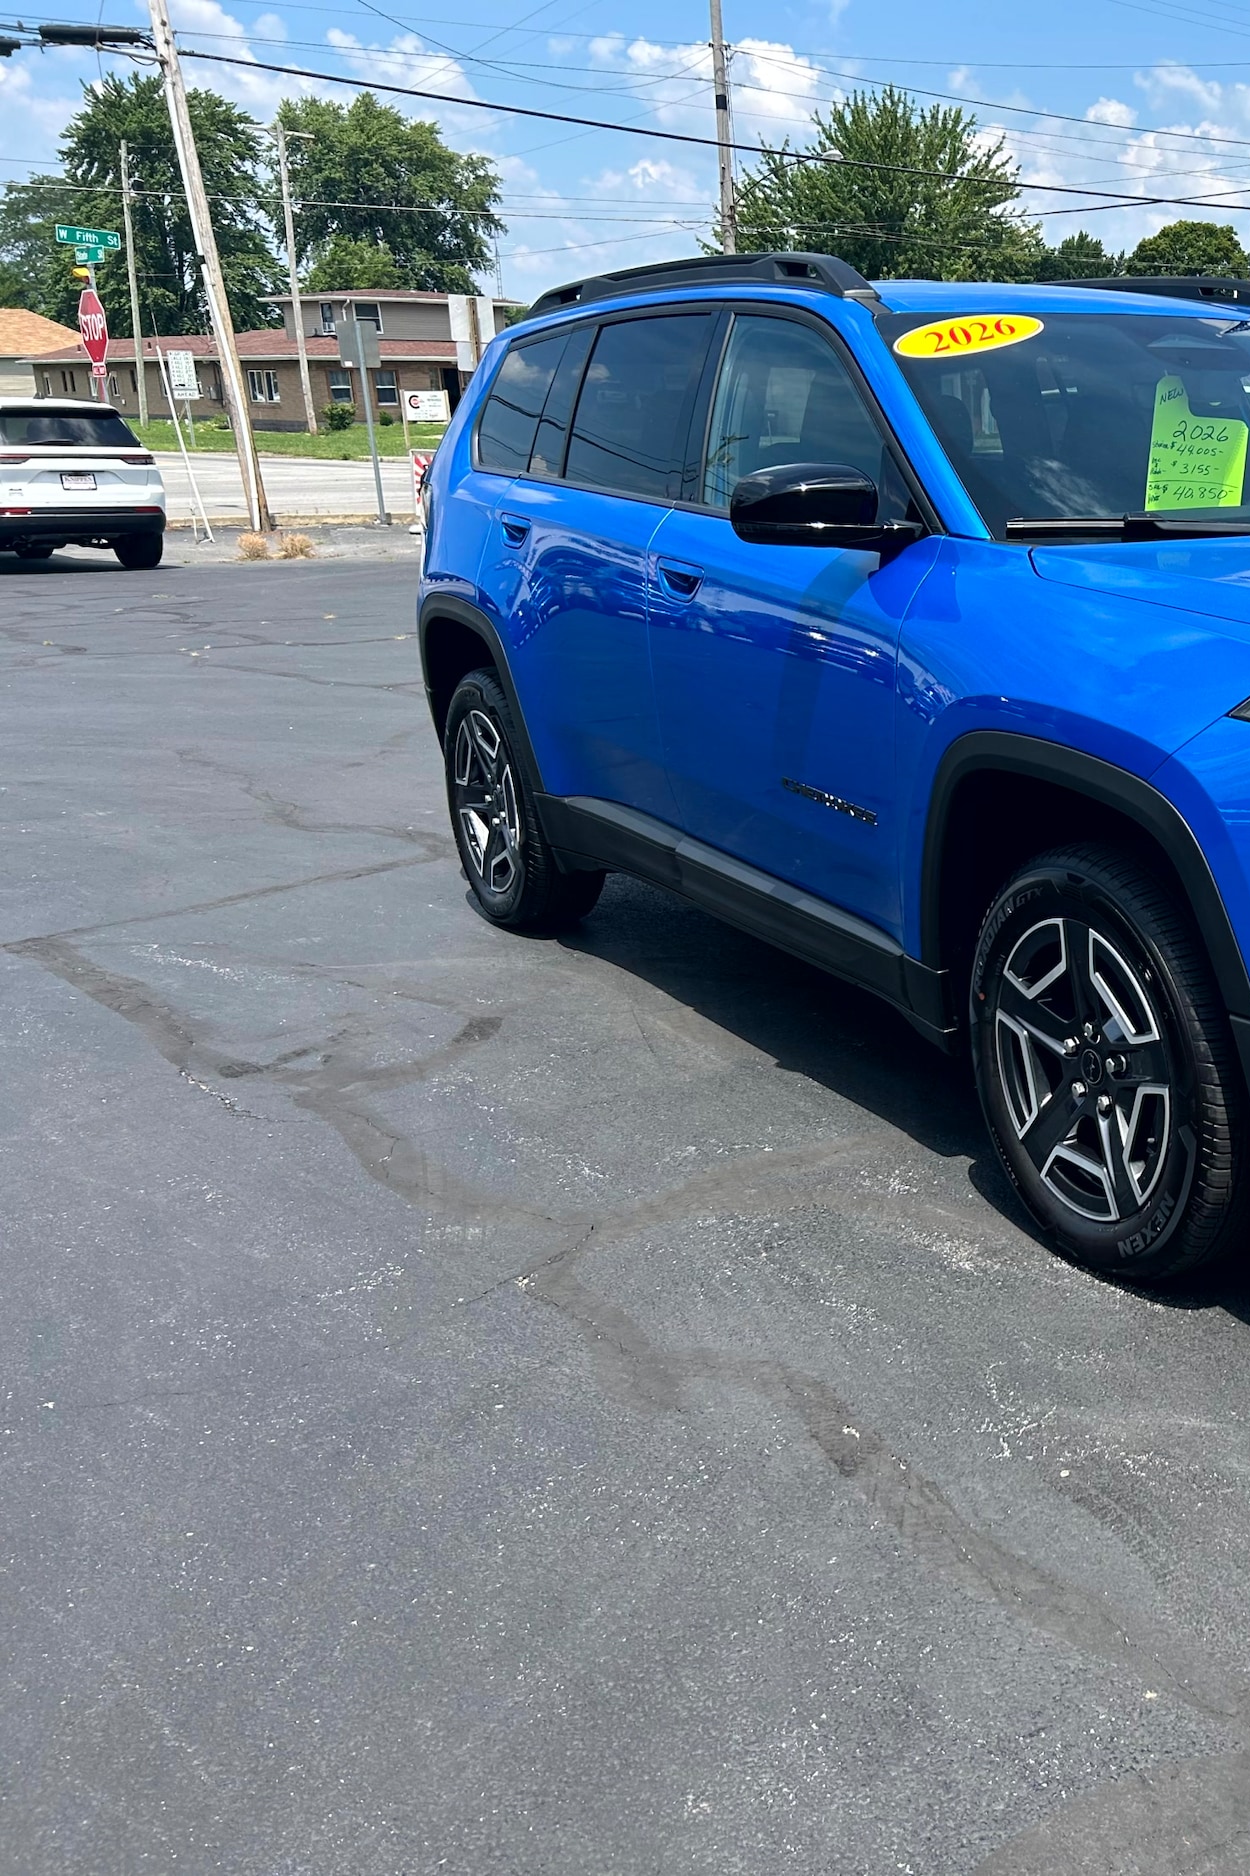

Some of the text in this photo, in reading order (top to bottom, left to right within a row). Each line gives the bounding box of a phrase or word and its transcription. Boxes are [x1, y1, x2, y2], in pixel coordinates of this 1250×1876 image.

[59, 229, 118, 246] W Fifth St
[81, 313, 104, 341] STOP
[924, 319, 1016, 353] 2026
[1159, 388, 1184, 405] NEW
[1172, 420, 1229, 442] 2026
[1117, 1190, 1175, 1259] NEXEN
